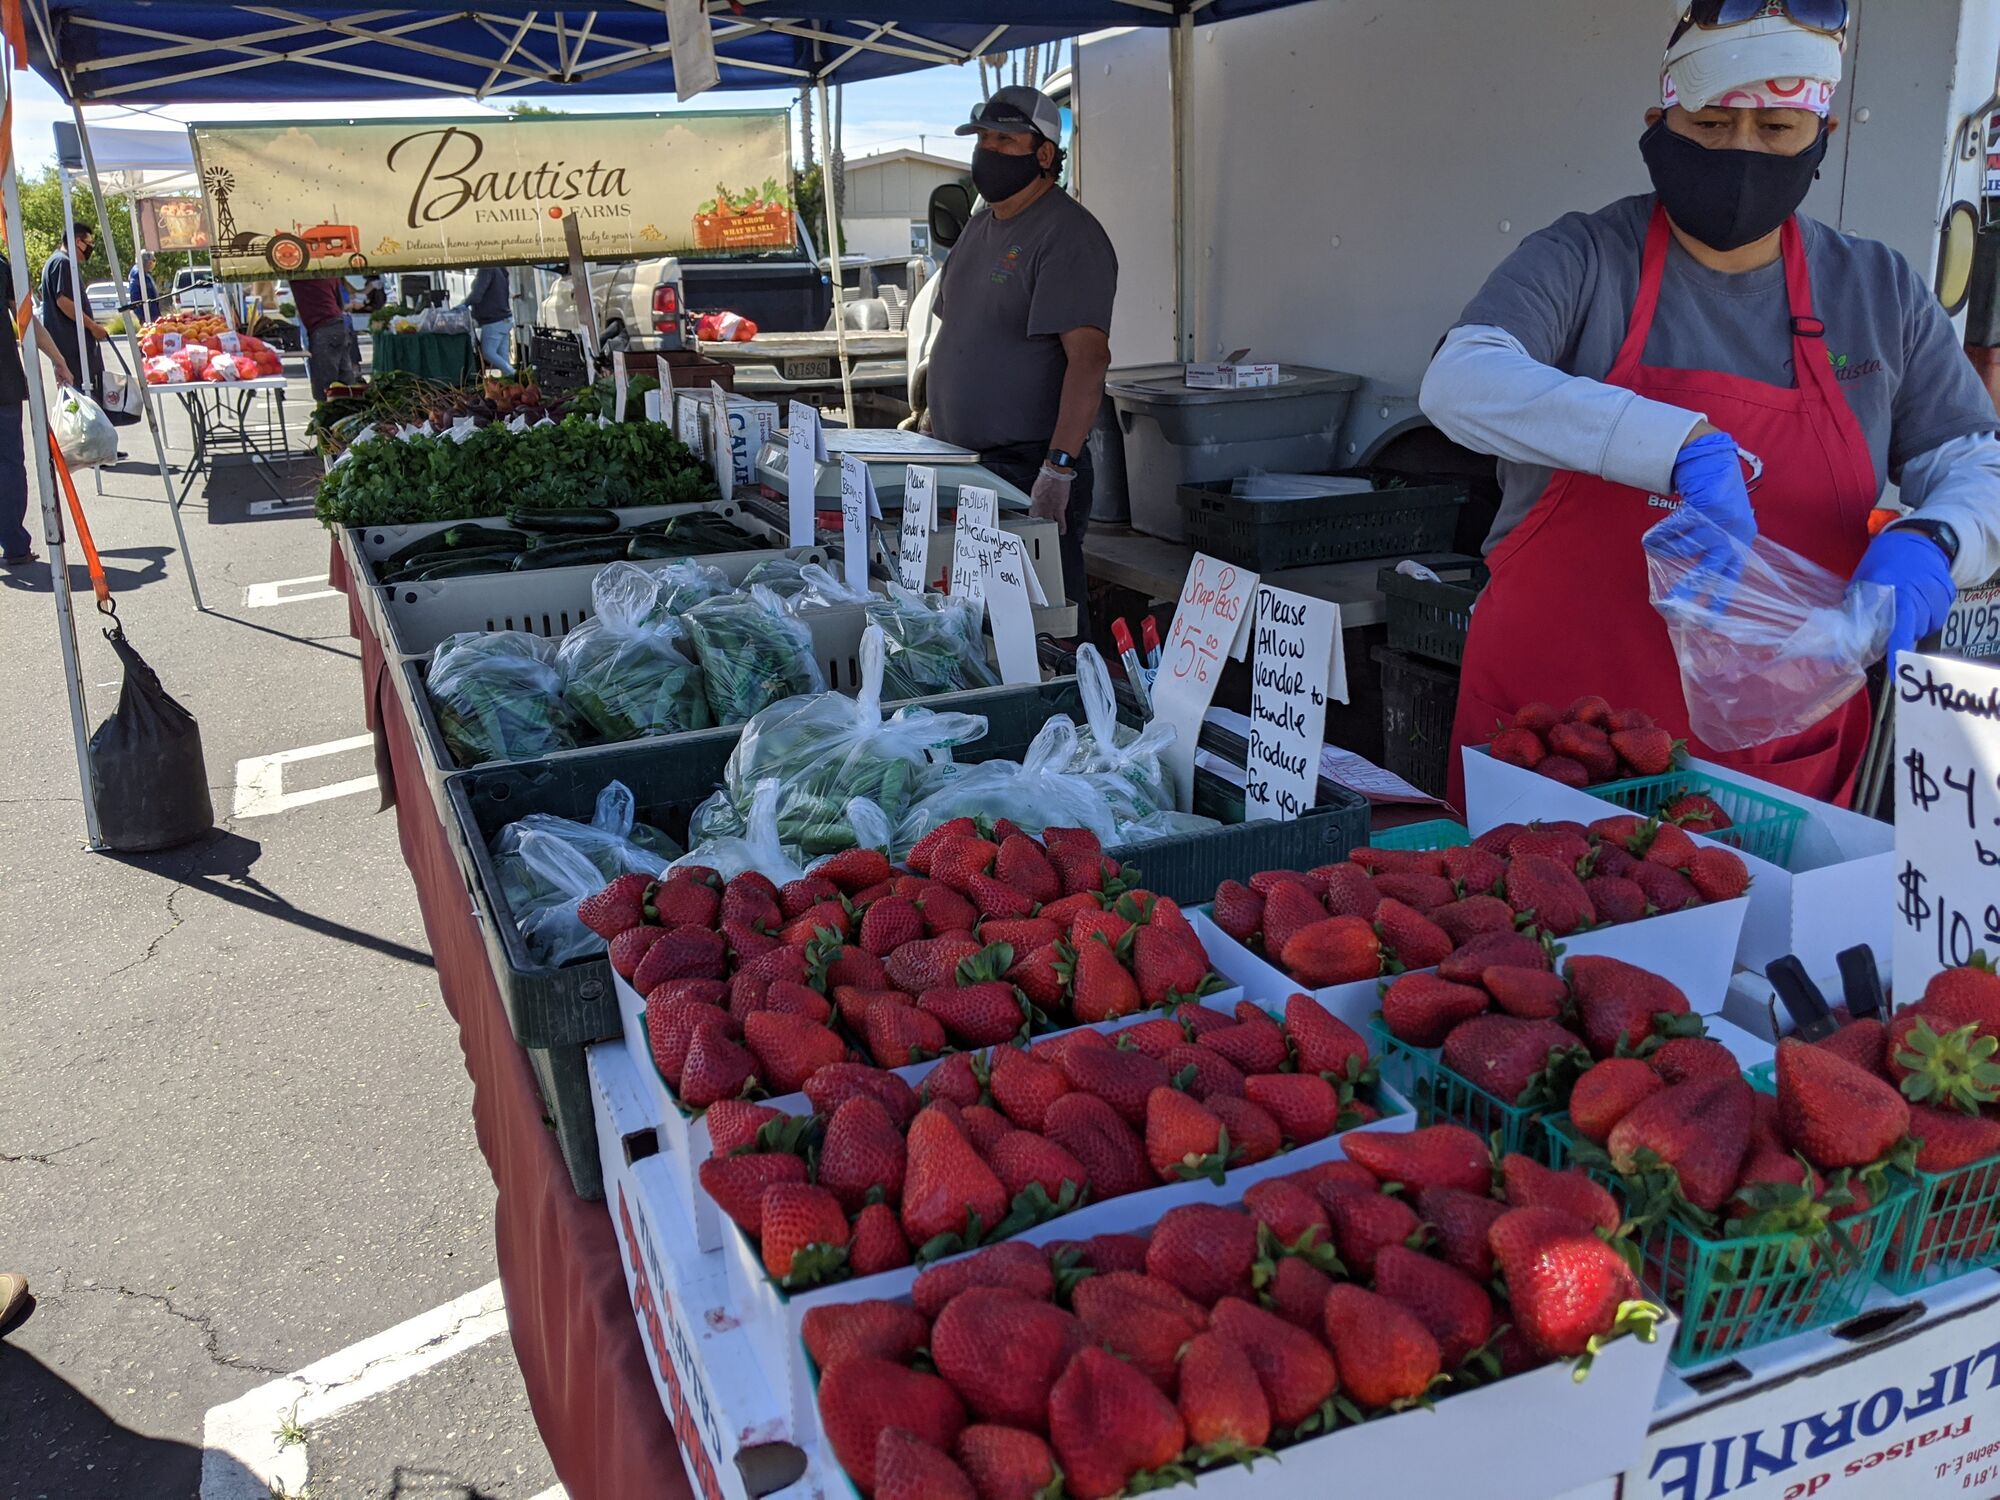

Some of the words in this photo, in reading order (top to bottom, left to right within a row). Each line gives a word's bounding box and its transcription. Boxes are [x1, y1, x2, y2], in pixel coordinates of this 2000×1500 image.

[387, 127, 631, 229] Bautista
[475, 206, 542, 223] FAMILY
[570, 203, 632, 218] FARMS
[731, 219, 743, 227] WE
[743, 216, 764, 225] GROW
[406, 239, 445, 250] Delicious
[482, 252, 508, 262] Road
[958, 487, 989, 513] English
[1648, 495, 1681, 510] Bau
[955, 538, 977, 563] Peas
[1000, 571, 1021, 587] each
[1184, 558, 1214, 620] Snap
[1212, 565, 1241, 622] Peas
[1259, 589, 1307, 626] Please
[1945, 604, 2000, 649] 8V95
[1257, 627, 1305, 659] Allow
[1310, 685, 1324, 707] to
[1253, 693, 1307, 738] Handle
[1250, 729, 1307, 780] Produce
[1276, 789, 1308, 822] you
[1843, 1414, 1974, 1477] Fraises
[1783, 1471, 1832, 1500] de
